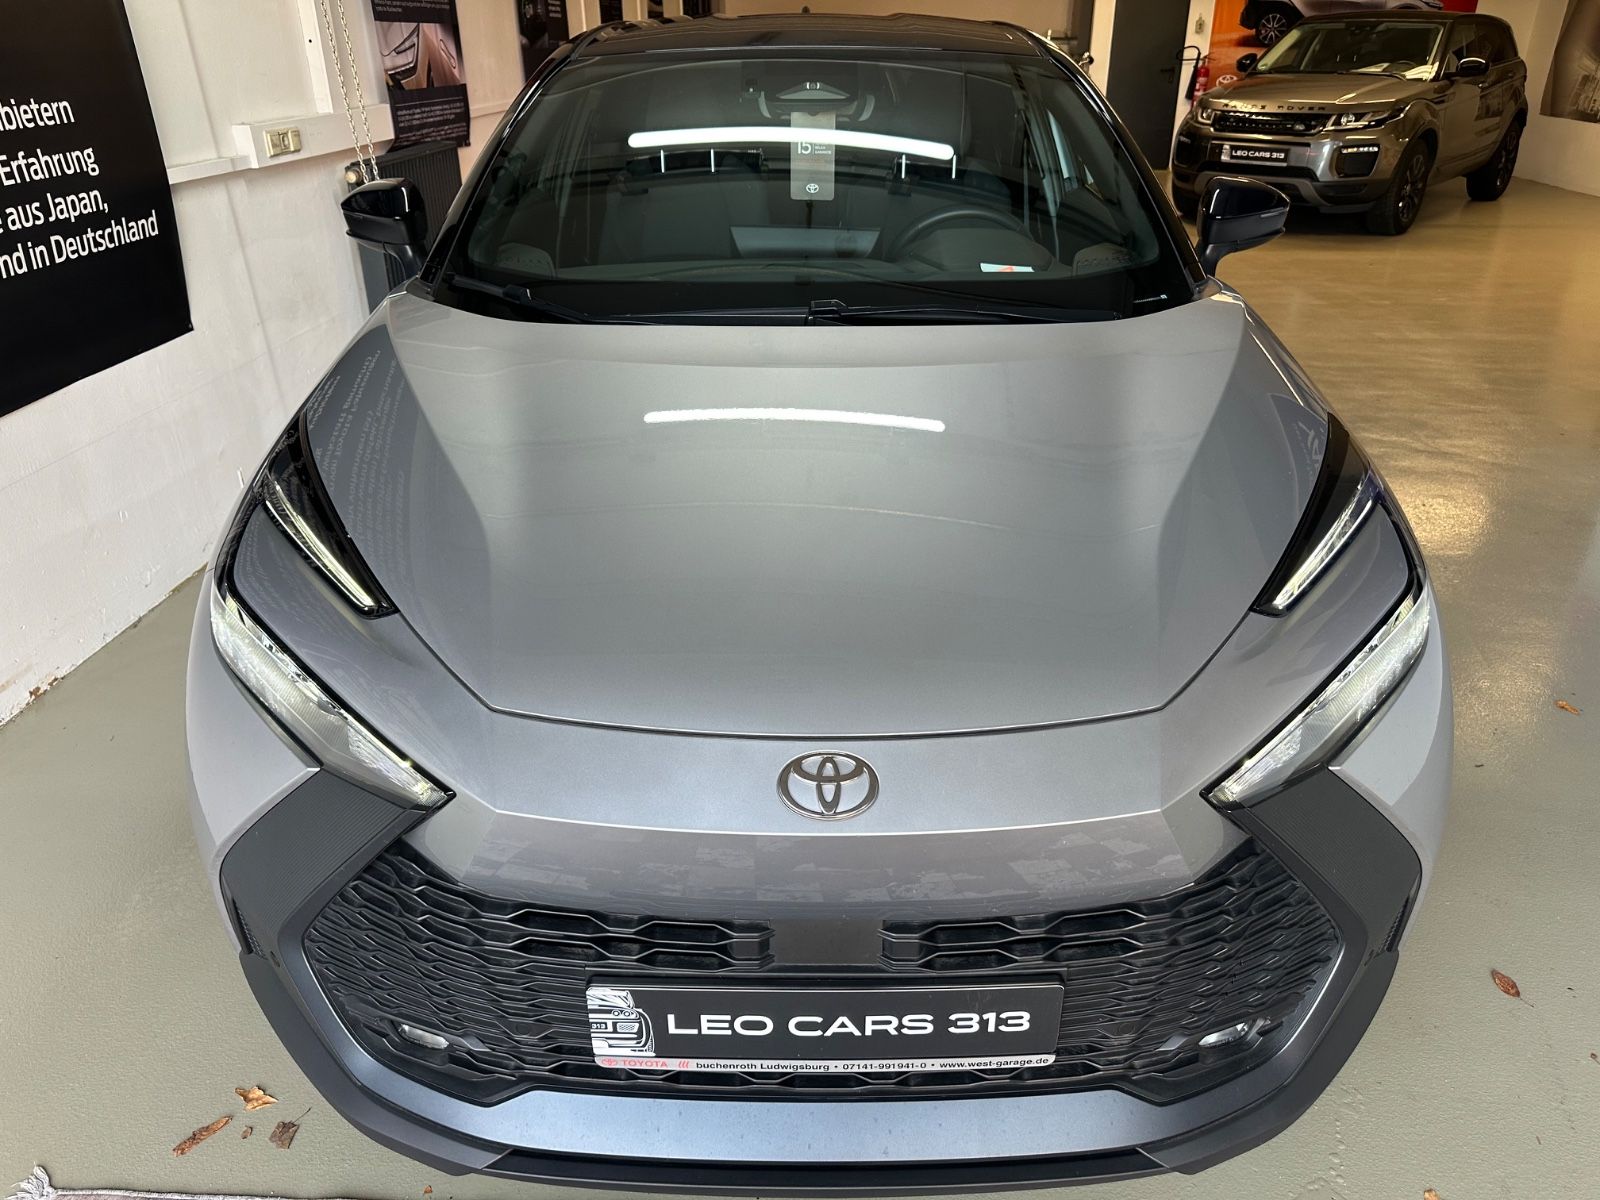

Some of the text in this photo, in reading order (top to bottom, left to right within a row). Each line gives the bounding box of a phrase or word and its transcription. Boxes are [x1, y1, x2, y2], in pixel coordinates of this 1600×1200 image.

[0, 147, 100, 186] Erfahrung
[1232, 149, 1248, 157] LEO
[5, 201, 44, 231] aus
[46, 189, 109, 222] Japan,
[27, 241, 51, 270] in
[50, 209, 159, 263] Deutschland
[667, 1011, 1031, 1037] LEO CARS 313
[622, 1057, 1049, 1071] TOYOTA buchenroth Ludwigsburg 07141-991941-0 www.west-garage.de
